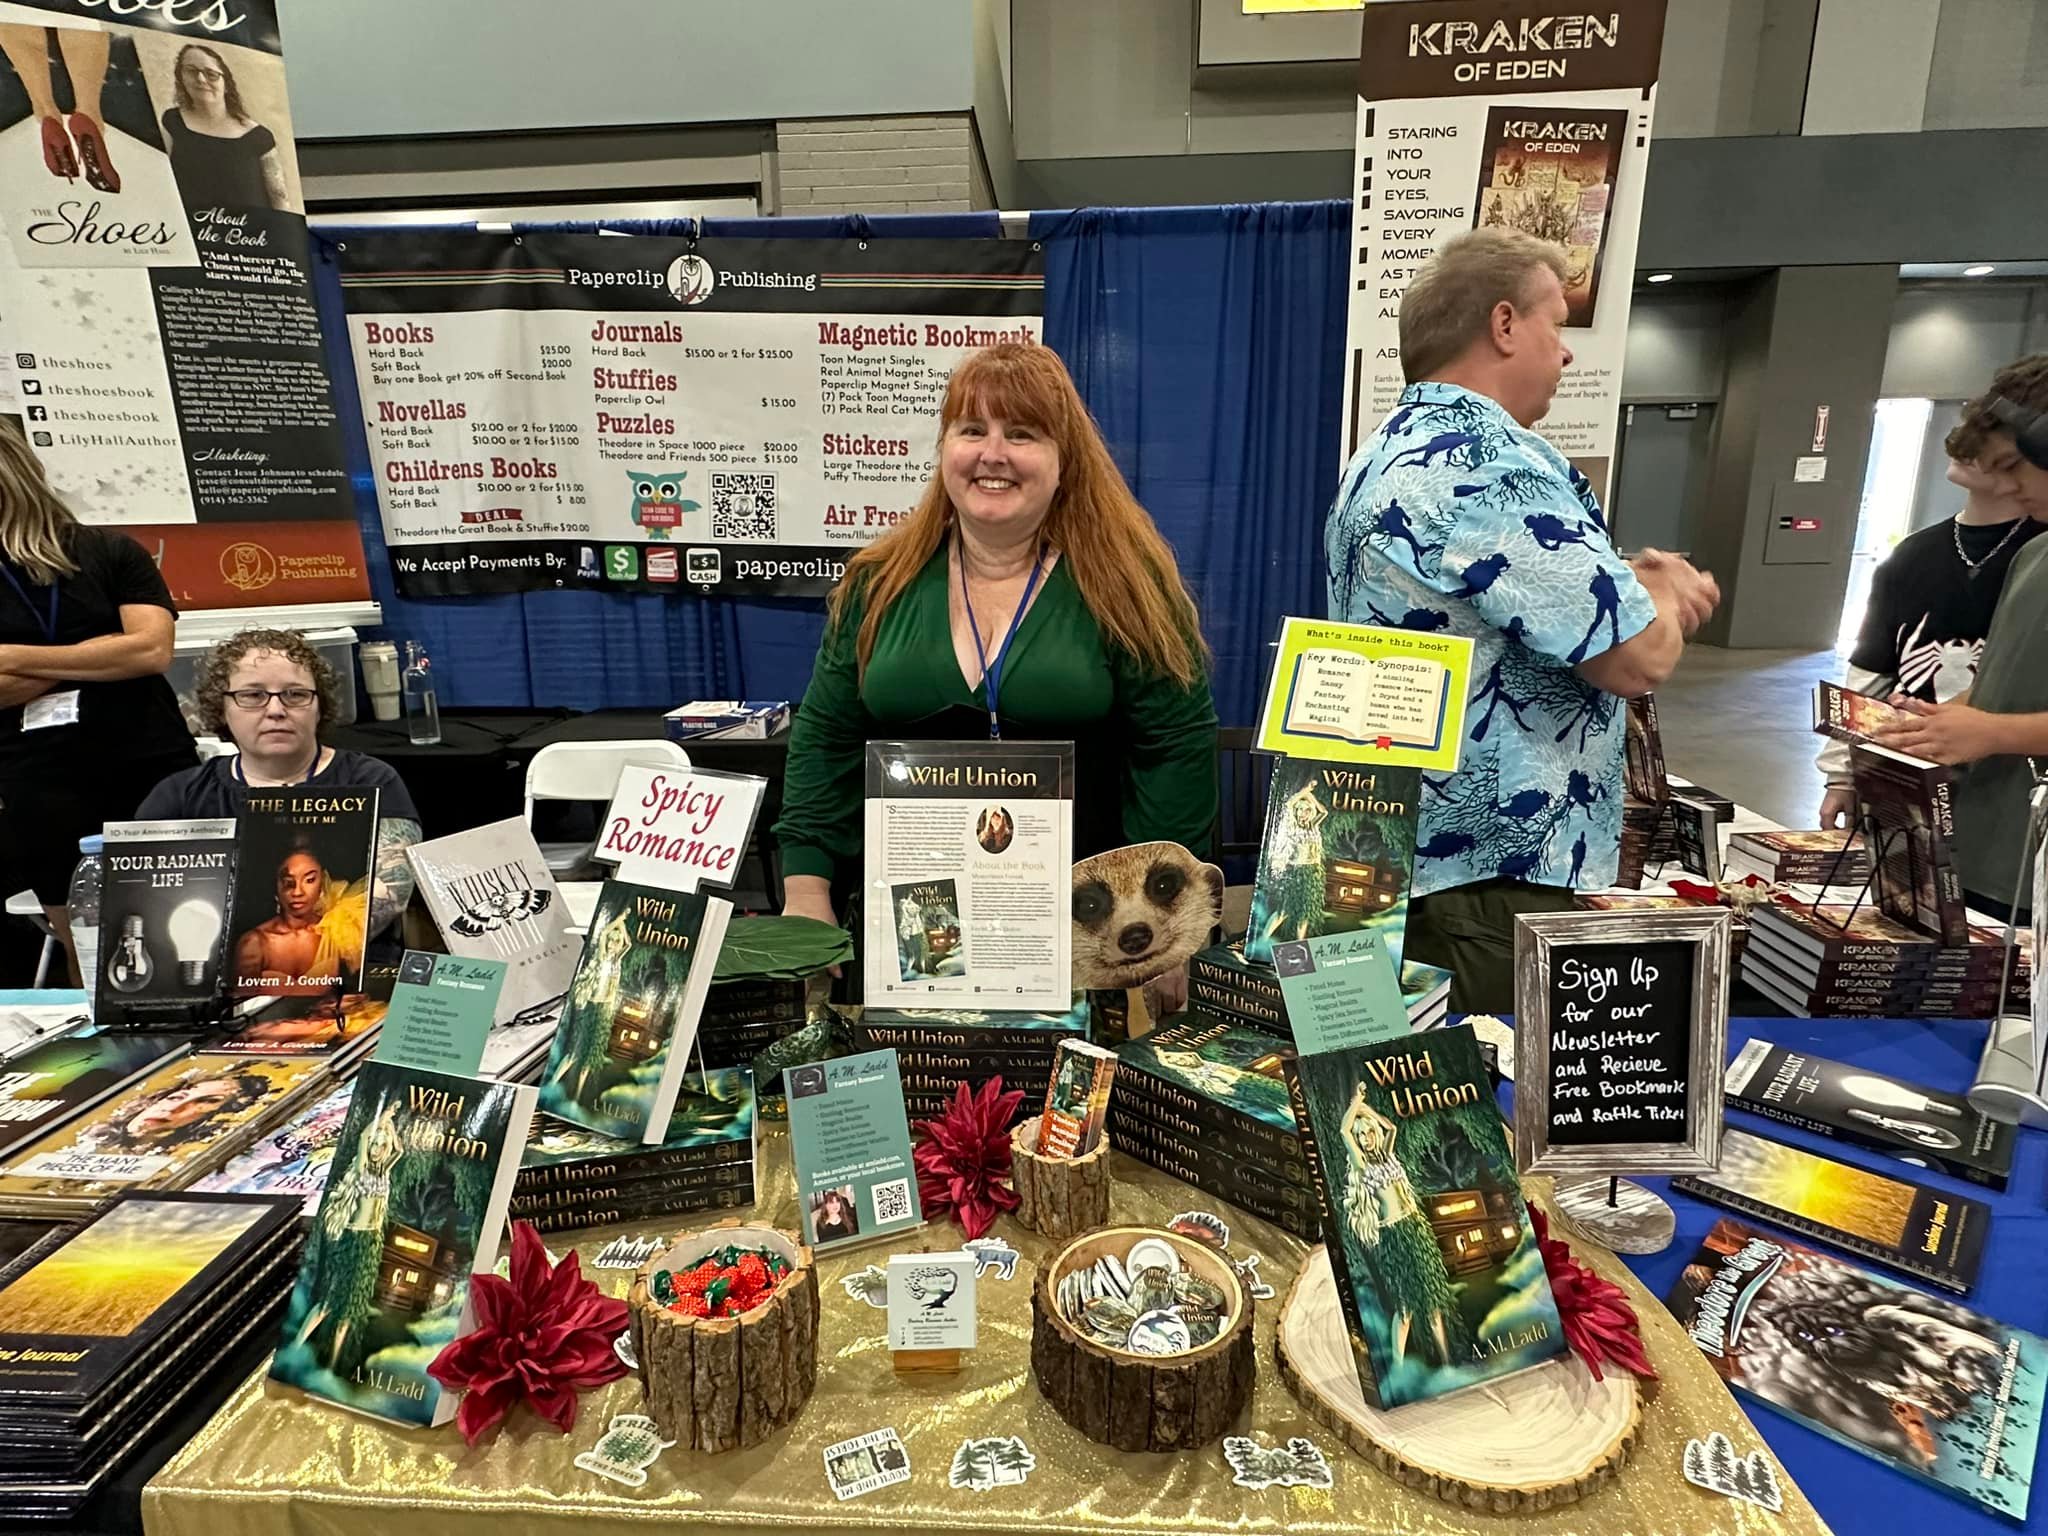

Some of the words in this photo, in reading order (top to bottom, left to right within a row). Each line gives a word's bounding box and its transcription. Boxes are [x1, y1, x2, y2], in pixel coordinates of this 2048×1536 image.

[1409, 13, 1619, 57] KRAKEN
[1454, 63, 1490, 82] OF
[1496, 58, 1566, 81] EDEN
[1388, 127, 1457, 139] STARING
[1503, 121, 1607, 141] KRAKEN
[1387, 149, 1422, 159] INTO
[1525, 143, 1541, 152] OF
[1545, 143, 1580, 153] EDEN
[1387, 169, 1431, 180] YOUR
[1385, 189, 1428, 201] EYES,
[27, 201, 176, 244] Shoes
[194, 208, 247, 225] About
[1384, 208, 1464, 220] SAVORING
[198, 225, 221, 242] the
[225, 228, 268, 246] Book
[1383, 228, 1435, 240] EVERY
[204, 261, 240, 272] Chosen
[242, 265, 272, 274] would
[274, 268, 289, 277] go,
[290, 270, 304, 278] the
[232, 255, 276, 265] wherever
[278, 258, 296, 268] The
[569, 269, 664, 288] Paperclip
[719, 271, 816, 291] Publishing
[365, 322, 433, 344] Books
[591, 320, 683, 343] Journals
[818, 322, 917, 351] Magnetic
[369, 349, 397, 357] Hard
[400, 348, 424, 358] Back
[540, 345, 571, 355] $25.00
[592, 347, 619, 356] Hard
[622, 348, 646, 358] Back
[686, 349, 715, 358] $15.00
[718, 351, 728, 359] or
[731, 349, 738, 359] 2
[741, 350, 755, 359] for
[758, 350, 792, 360] $25.00
[42, 358, 112, 371] theshoes
[371, 362, 394, 371] Soft
[396, 362, 421, 371] Back
[542, 359, 572, 368] $20.00
[821, 354, 843, 365] Toon
[847, 355, 886, 367] Magnet
[889, 355, 925, 367] Singles
[593, 368, 677, 391] Stuffies
[48, 384, 154, 398] theshoesbook
[595, 394, 641, 405] Paperclip
[645, 396, 665, 405] Owl
[762, 397, 796, 408] $15.00
[54, 410, 160, 422] theshoesbook
[379, 401, 466, 423] Novellas
[381, 426, 408, 436] Hard
[410, 426, 433, 436] Back
[471, 423, 504, 433] $12.00
[522, 423, 528, 432] 2
[532, 423, 546, 433] for
[549, 423, 578, 433] $20.00
[597, 412, 675, 435] Puzzles
[59, 434, 177, 448] LilyHallAuthor
[599, 438, 643, 449] Theodore
[646, 439, 655, 449] in
[659, 439, 689, 451] Space
[692, 442, 716, 451] 1000
[719, 441, 745, 453] piece
[763, 442, 798, 452] $20.00
[823, 434, 909, 456] Stickers
[599, 451, 643, 461] Theodore
[646, 451, 666, 461] and
[670, 451, 706, 462] Friends
[709, 454, 728, 463] 500
[731, 454, 757, 465] piece
[763, 454, 798, 464] $15.00
[387, 460, 483, 483] Childrens
[491, 457, 557, 479] Books
[476, 510, 509, 522] DEAL
[824, 505, 856, 526] Air
[279, 555, 345, 566] Paperclip
[397, 558, 419, 573] We
[422, 555, 466, 573] Accept
[470, 555, 541, 571] Payments
[546, 554, 566, 570] By:
[281, 568, 357, 580] Publishing
[690, 573, 717, 582] CASH
[1307, 629, 1341, 639] What's
[1348, 634, 1383, 644] inside
[1389, 637, 1412, 648] this
[1419, 642, 1449, 652] book?
[1307, 653, 1325, 663] Key
[1331, 655, 1365, 666] Words:
[1377, 660, 1431, 674] Synopsis:
[1318, 668, 1351, 677] Romance
[1314, 691, 1345, 700] Fantasy
[1305, 701, 1350, 713] Enchanting
[1309, 713, 1340, 723] Magical
[907, 766, 960, 787] Wild
[966, 766, 1038, 787] Union
[1323, 770, 1376, 791] Wild
[248, 799, 284, 813] THE
[291, 797, 367, 813] LEGACY
[642, 776, 725, 834] Spicy
[1332, 792, 1404, 815] Union
[1937, 783, 1954, 836] KRAKEN
[190, 827, 228, 835] Anthology
[604, 817, 735, 870] Romance
[110, 856, 154, 870] YOUR
[157, 853, 226, 869] RADIANT
[152, 873, 183, 887] LIFE
[636, 897, 676, 922] Wild
[636, 922, 689, 950] Union
[1843, 945, 1900, 954] KRAKEN
[238, 975, 280, 987] Lovern
[284, 975, 295, 987] J.
[298, 974, 343, 986] Gordon
[1199, 961, 1232, 984] Wild
[1235, 973, 1281, 998] Union
[1558, 959, 1618, 1003] Sign
[1630, 957, 1659, 990] Up
[1561, 1002, 1594, 1023] for
[1610, 1004, 1653, 1020] our
[867, 1028, 909, 1045] Wild
[912, 1030, 965, 1046] Union
[1552, 1030, 1660, 1052] Newsletter
[1364, 1050, 1434, 1088] Wild
[1556, 1058, 1587, 1077] and
[1601, 1055, 1667, 1075] Recieve
[1115, 1062, 1147, 1089] Wild
[1151, 1077, 1198, 1112] Union
[1553, 1083, 1590, 1100] Free
[1599, 1080, 1685, 1098] Bookmark
[409, 1084, 466, 1120] Wild
[1389, 1080, 1480, 1119] Union
[1553, 1108, 1583, 1126] and
[1753, 1103, 1805, 1126] RADIANT
[1807, 1121, 1833, 1135] LIFE
[409, 1119, 488, 1161] Union
[36, 1163, 87, 1171] PIECES
[118, 1166, 142, 1174] ME
[95, 1156, 143, 1164] MANY
[1471, 1343, 1488, 1361] A.
[1488, 1337, 1507, 1356] M.
[1511, 1322, 1548, 1350] Ladd
